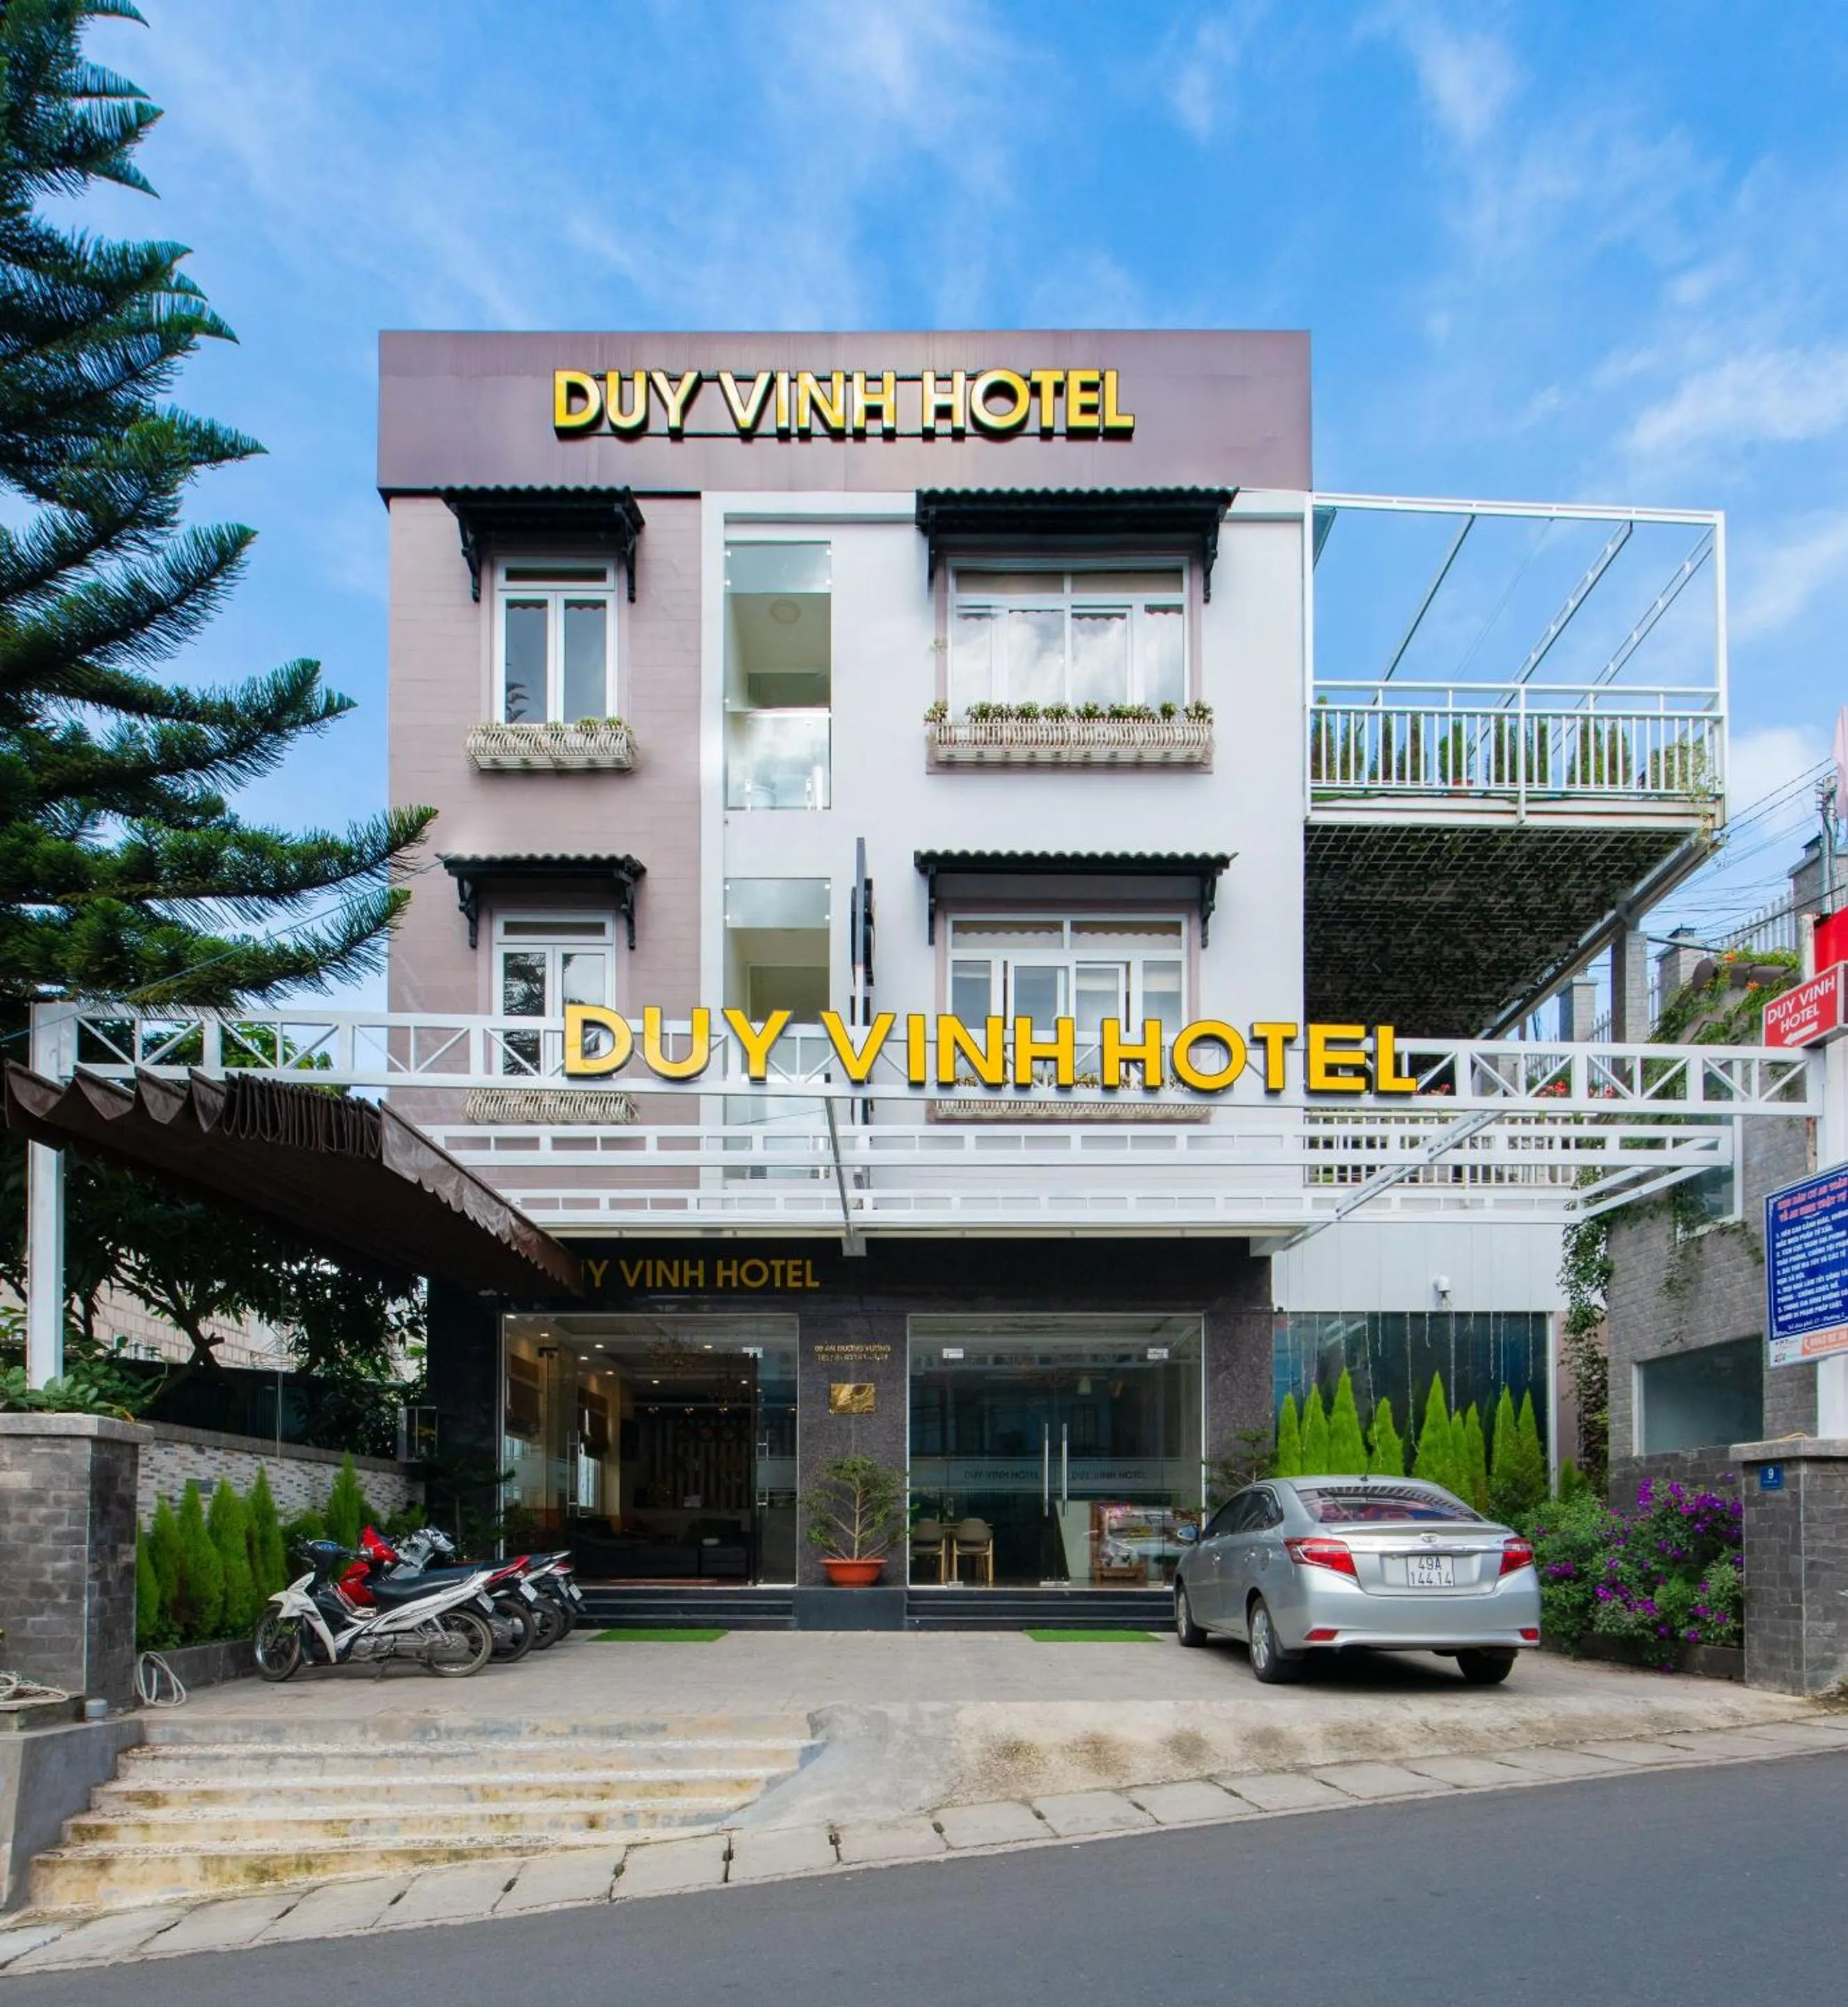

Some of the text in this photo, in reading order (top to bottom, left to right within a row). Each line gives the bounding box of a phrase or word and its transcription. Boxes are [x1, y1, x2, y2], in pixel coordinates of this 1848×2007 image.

[553, 368, 1134, 438] DUY VINH HOTEL
[1767, 975, 1835, 1024] DUY VINH
[1780, 1003, 1820, 1034] HOTEL
[564, 1004, 1419, 1094] DUY VINH HOTEL
[619, 1259, 704, 1288] VINH
[716, 1259, 820, 1288] HOTEL
[1768, 1468, 1774, 1479] 9
[1410, 1571, 1452, 1584] 144.14
[1418, 1556, 1442, 1570] 49A
